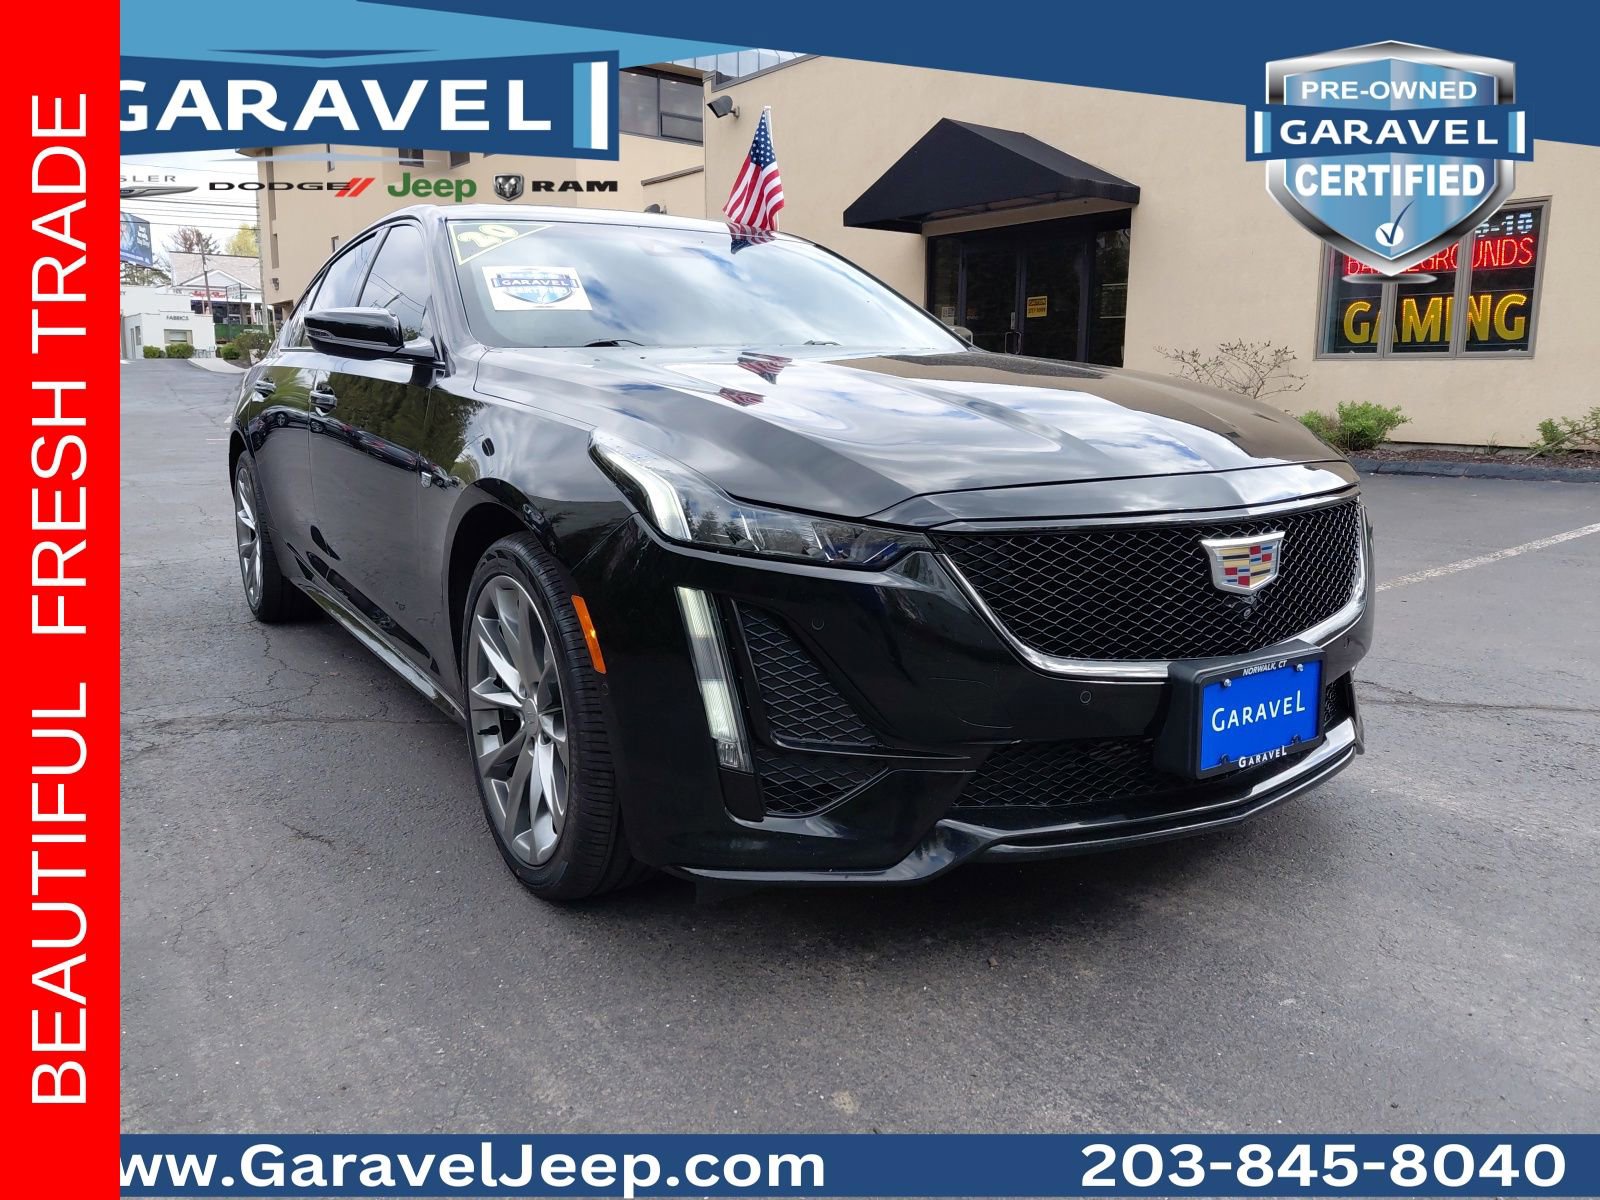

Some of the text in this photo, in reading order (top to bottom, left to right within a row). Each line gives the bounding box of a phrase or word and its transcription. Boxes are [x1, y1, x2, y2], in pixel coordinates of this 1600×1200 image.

[457, 224, 519, 248] 20
[1347, 237, 1534, 275] BGROUNDS
[501, 279, 570, 287] GARAVEL
[1278, 660, 1287, 668] CT
[1211, 690, 1305, 732] GARAVEL
[1238, 745, 1287, 768] GARAVEL
